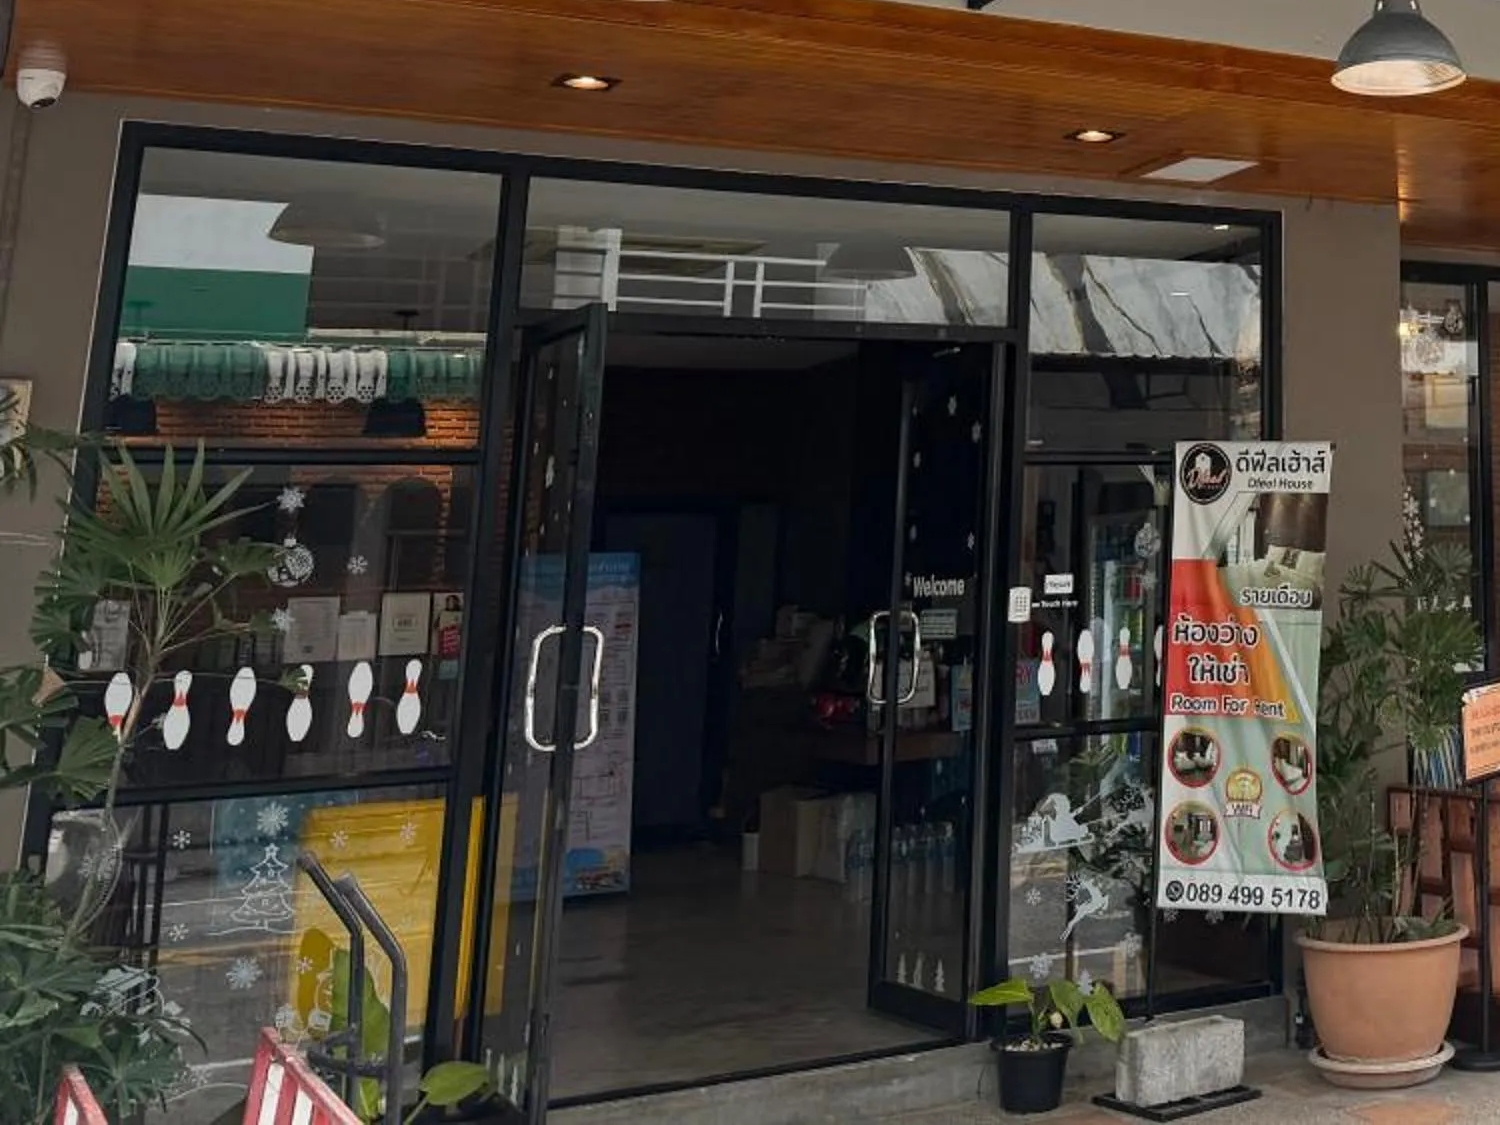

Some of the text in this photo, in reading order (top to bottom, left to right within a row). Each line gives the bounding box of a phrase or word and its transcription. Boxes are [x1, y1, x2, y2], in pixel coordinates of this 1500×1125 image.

[1279, 477, 1313, 490] House
[912, 575, 966, 597] Welcome
[1174, 615, 1258, 646] ห้องว่าง
[1188, 655, 1250, 683] ให้เช่า
[1171, 695, 1217, 712] Room
[1222, 696, 1248, 712] For
[1185, 882, 1321, 910] 089 499 5178
